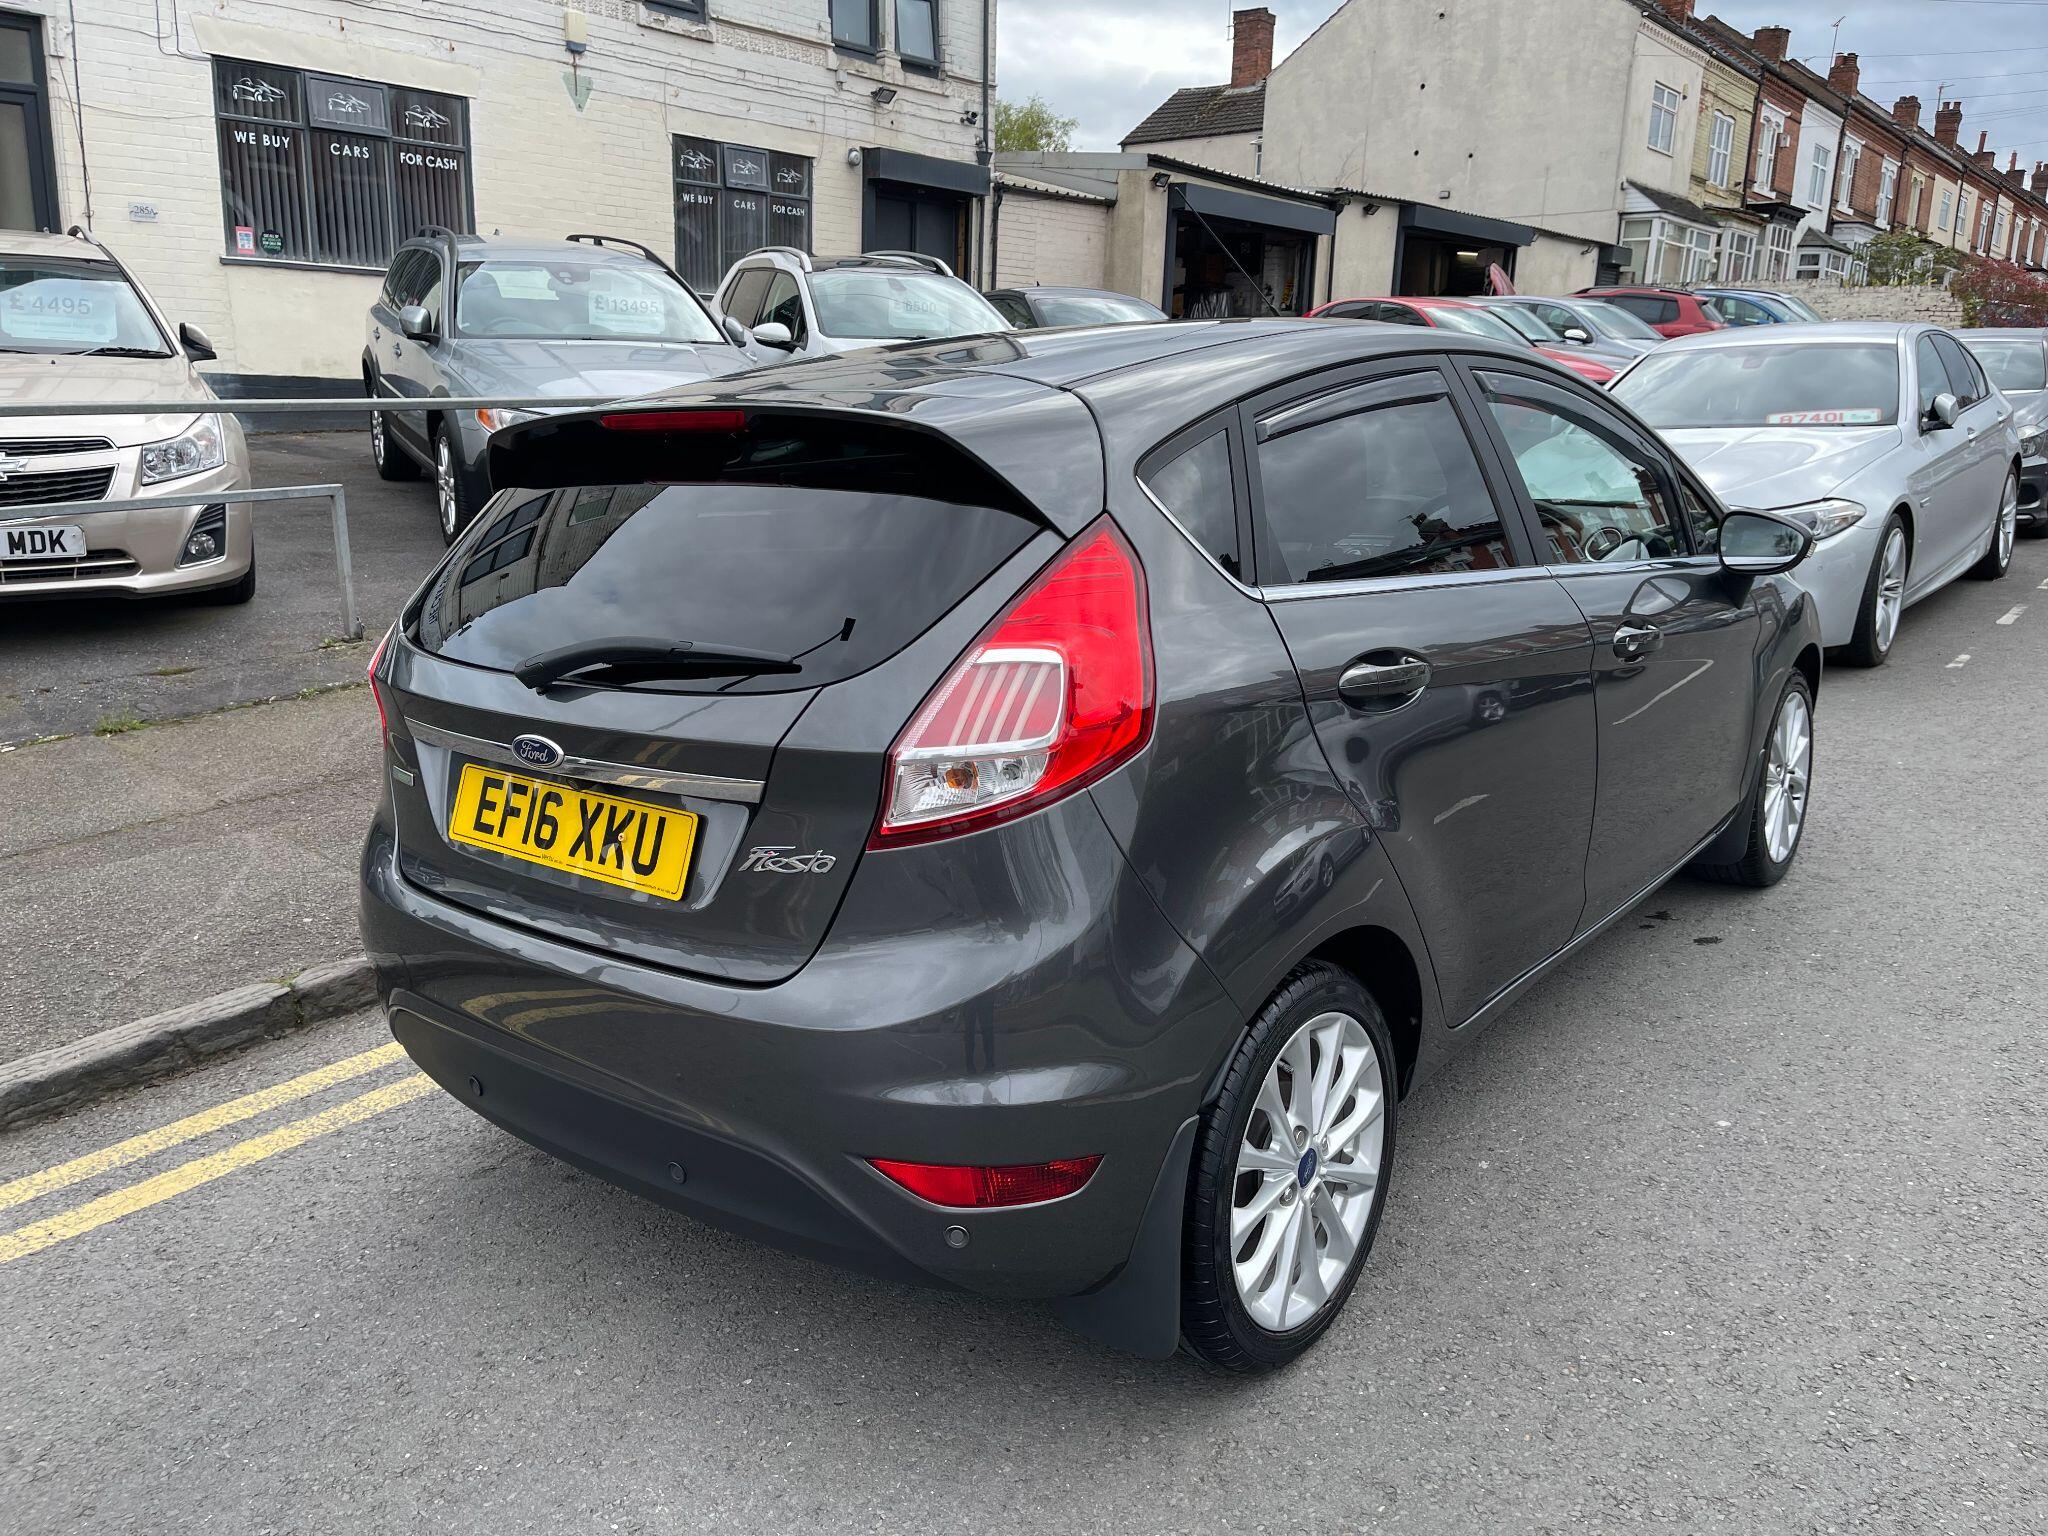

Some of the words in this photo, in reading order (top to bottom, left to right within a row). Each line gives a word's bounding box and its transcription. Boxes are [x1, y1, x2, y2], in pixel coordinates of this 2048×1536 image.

[234, 131, 256, 145] WE
[263, 134, 290, 149] BUY
[330, 143, 370, 158] CARS
[400, 152, 423, 166] FOR
[426, 155, 458, 170] CASH
[683, 193, 695, 203] WE
[697, 195, 714, 205] BUY
[733, 200, 756, 210] CARS
[772, 205, 786, 214] FOR
[787, 207, 805, 216] CASH
[7, 529, 67, 555] MDK
[520, 740, 549, 762] Ford
[473, 776, 563, 850] EF16
[568, 799, 667, 877] XKU
[738, 846, 837, 874] Fiesta
